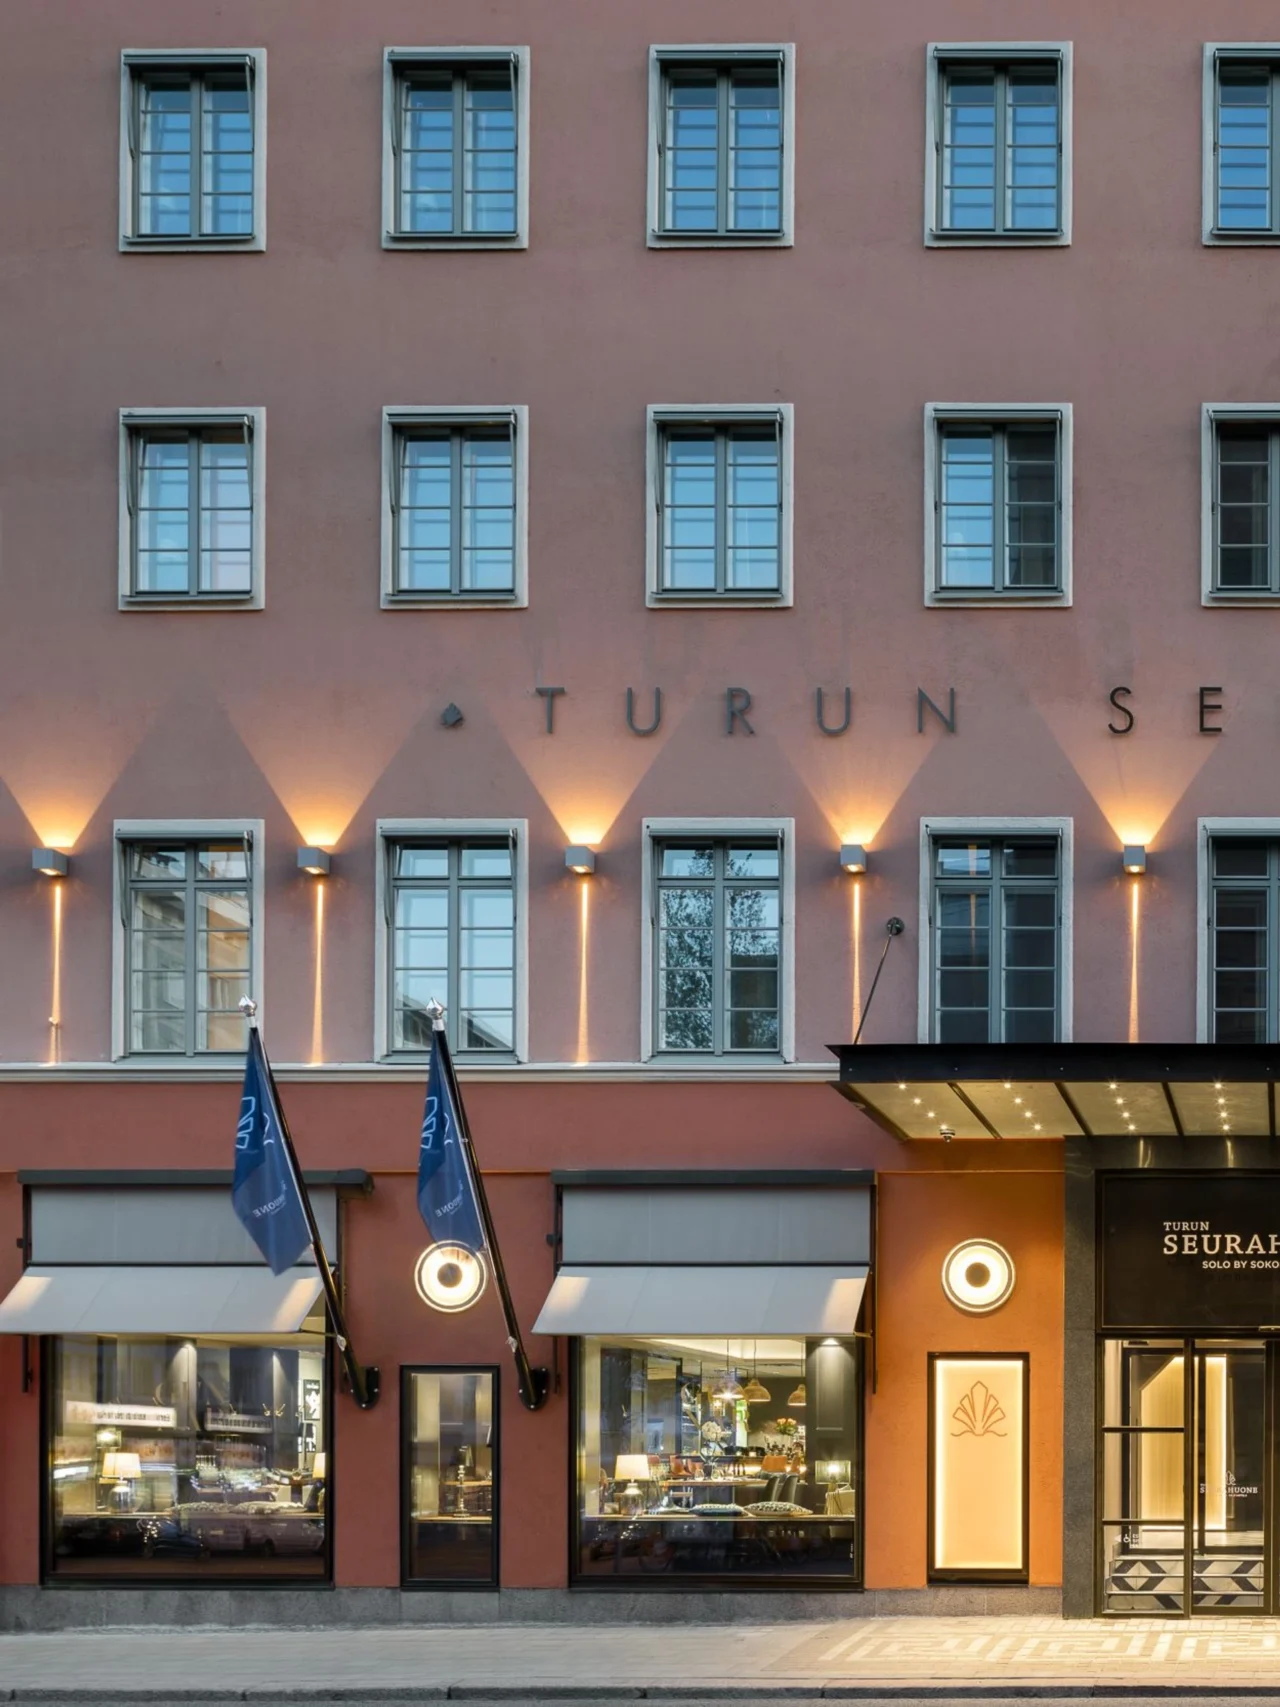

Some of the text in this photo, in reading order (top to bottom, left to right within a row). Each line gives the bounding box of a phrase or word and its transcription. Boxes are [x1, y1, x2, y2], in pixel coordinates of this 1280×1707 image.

[535, 687, 957, 738] TURUN
[1163, 1221, 1210, 1231] TURUN
[1202, 1260, 1231, 1269] SOLO
[1233, 1260, 1248, 1269] BY
